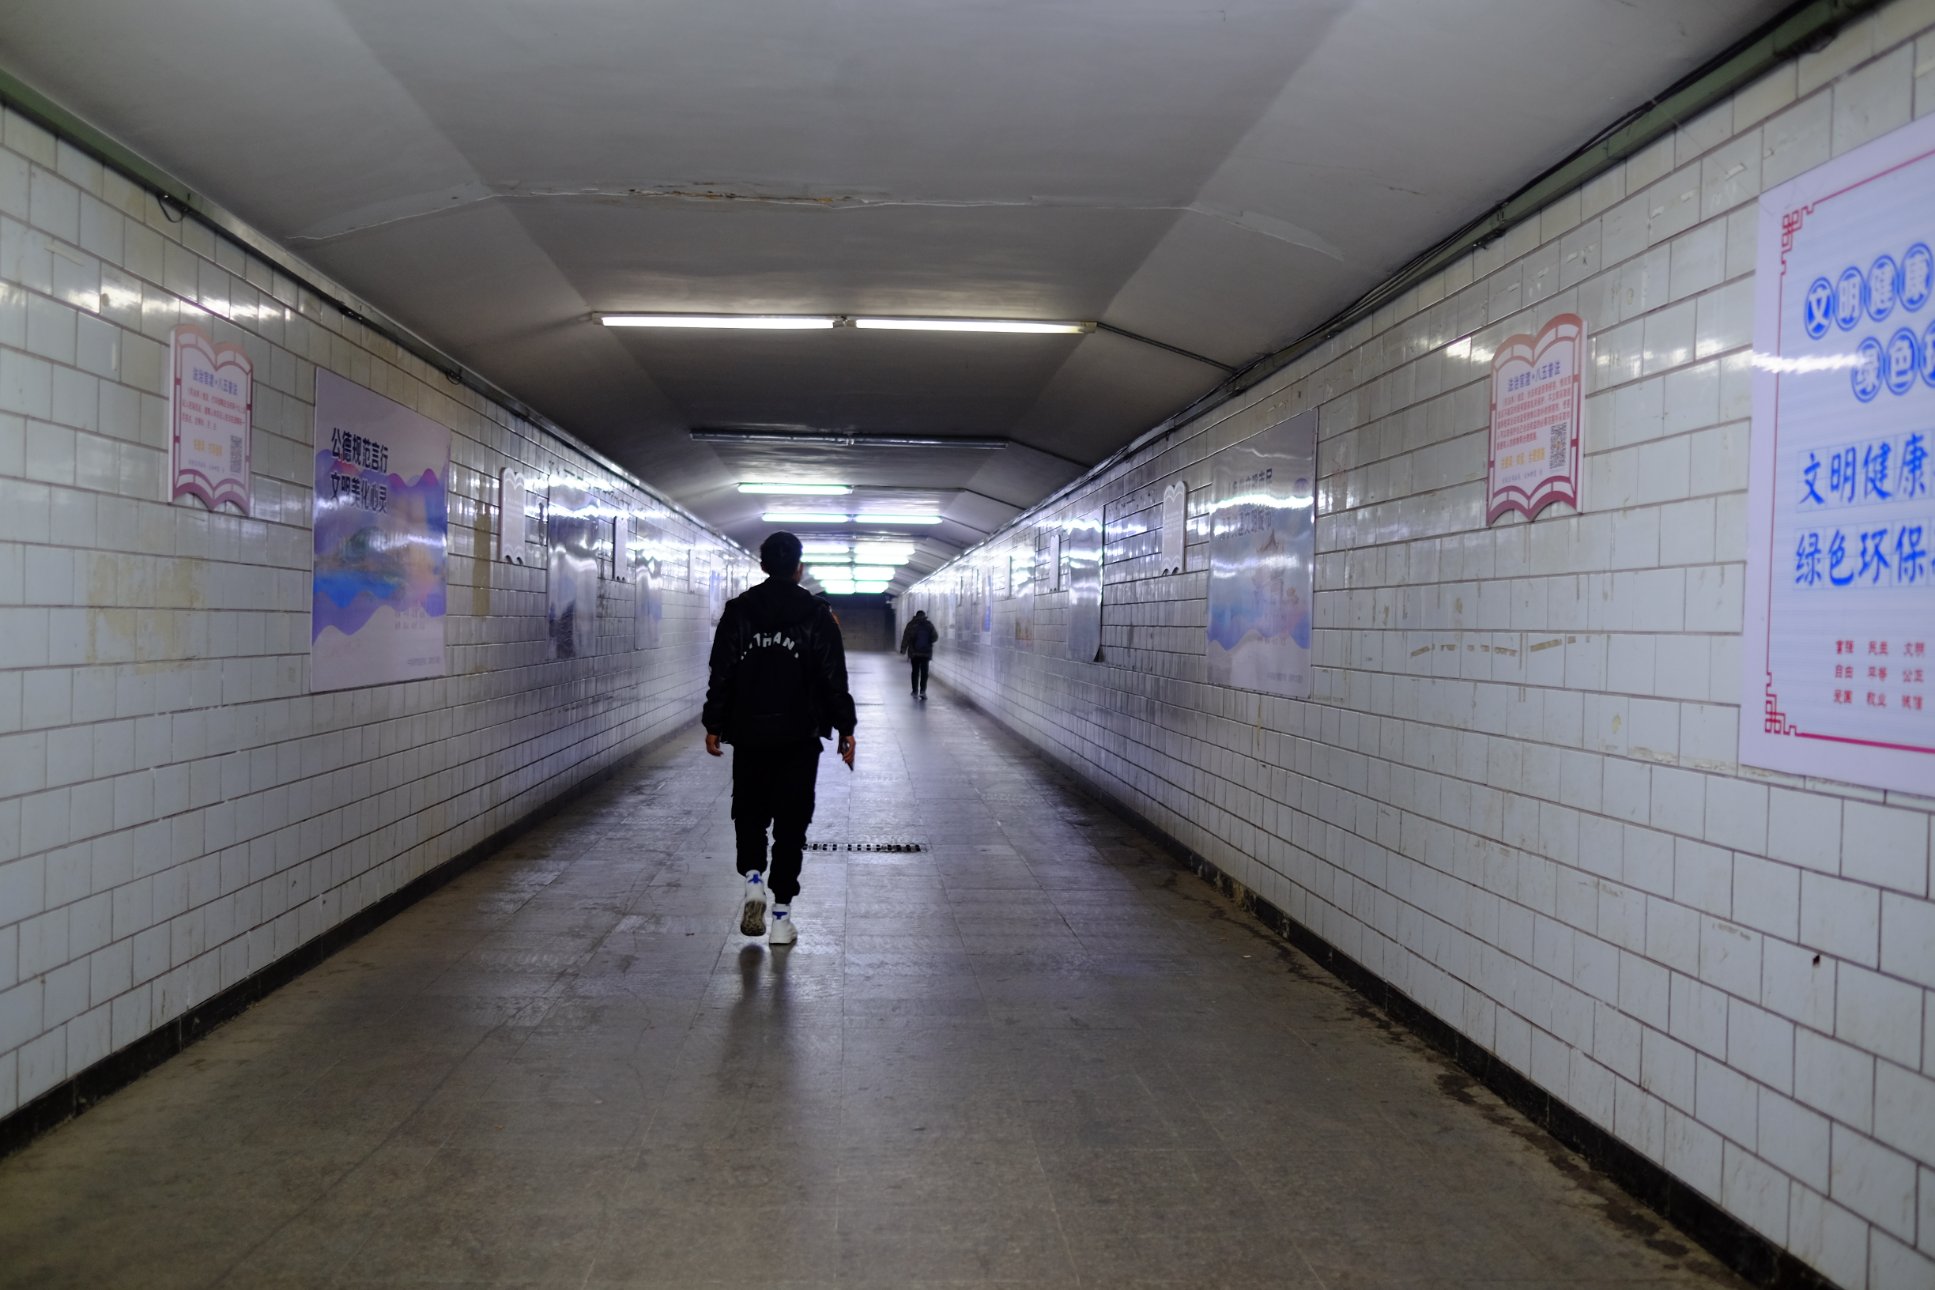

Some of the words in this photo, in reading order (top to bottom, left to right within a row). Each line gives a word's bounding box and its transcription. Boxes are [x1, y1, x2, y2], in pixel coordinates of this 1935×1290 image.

[1799, 432, 1935, 504] 文明健康
[1795, 525, 1935, 586] 绿色环保
